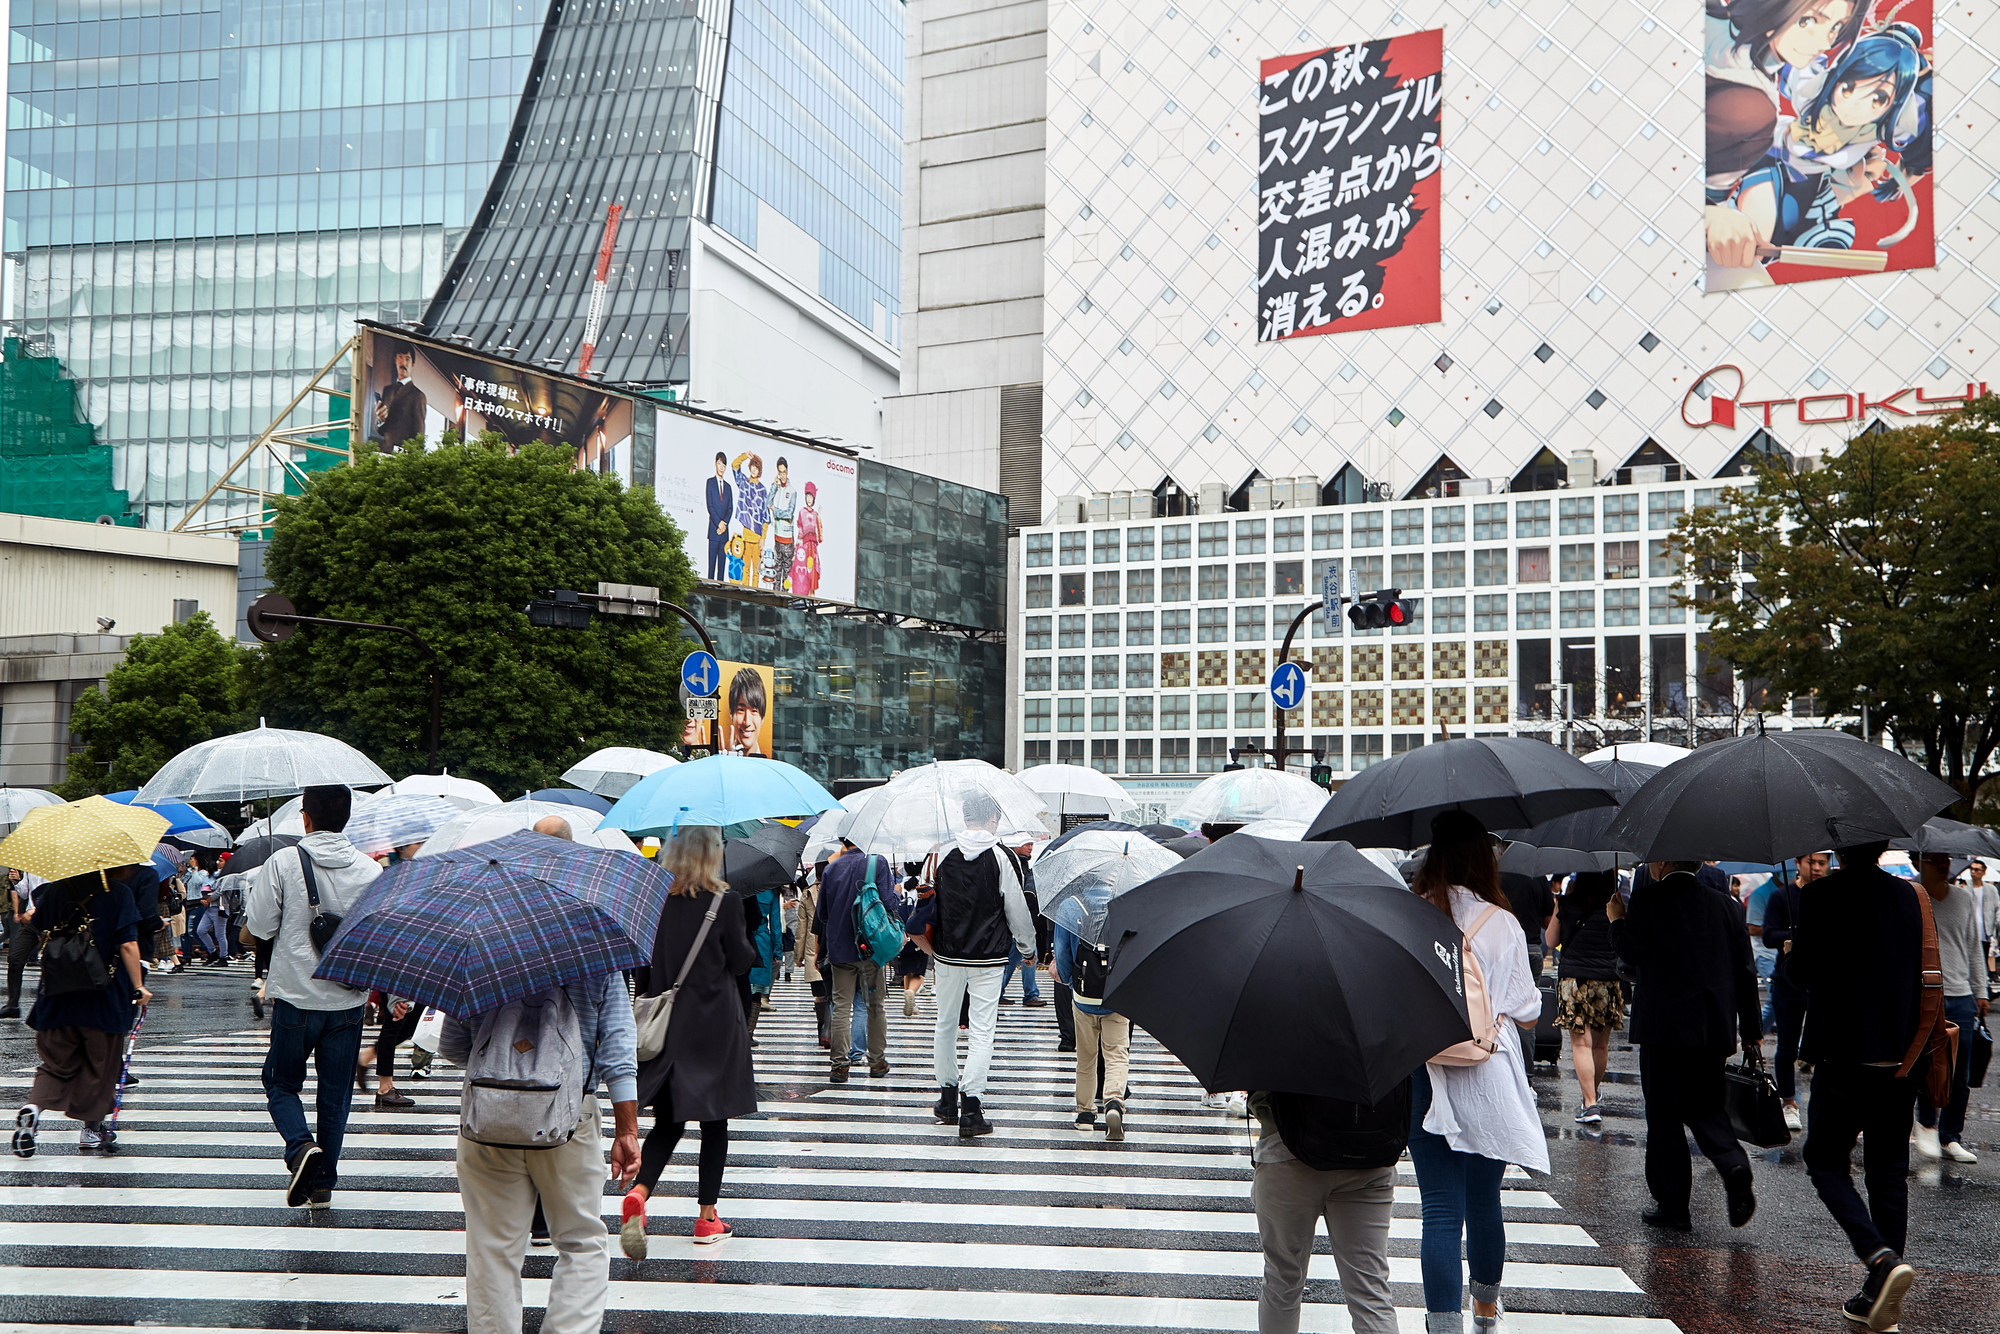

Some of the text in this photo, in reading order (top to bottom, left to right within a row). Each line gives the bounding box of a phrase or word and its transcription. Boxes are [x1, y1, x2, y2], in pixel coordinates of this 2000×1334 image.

[1259, 43, 1380, 116] この秋、
[1259, 74, 1443, 174] スクランブル
[1259, 132, 1442, 233] 交差点から
[1259, 195, 1415, 288] 人混みが
[1260, 269, 1385, 342] 消える。
[458, 374, 520, 403] 「事件現場は、
[1740, 381, 1987, 427] TOKY
[826, 459, 855, 475] docomo
[1329, 566, 1339, 627] 渋谷駅前
